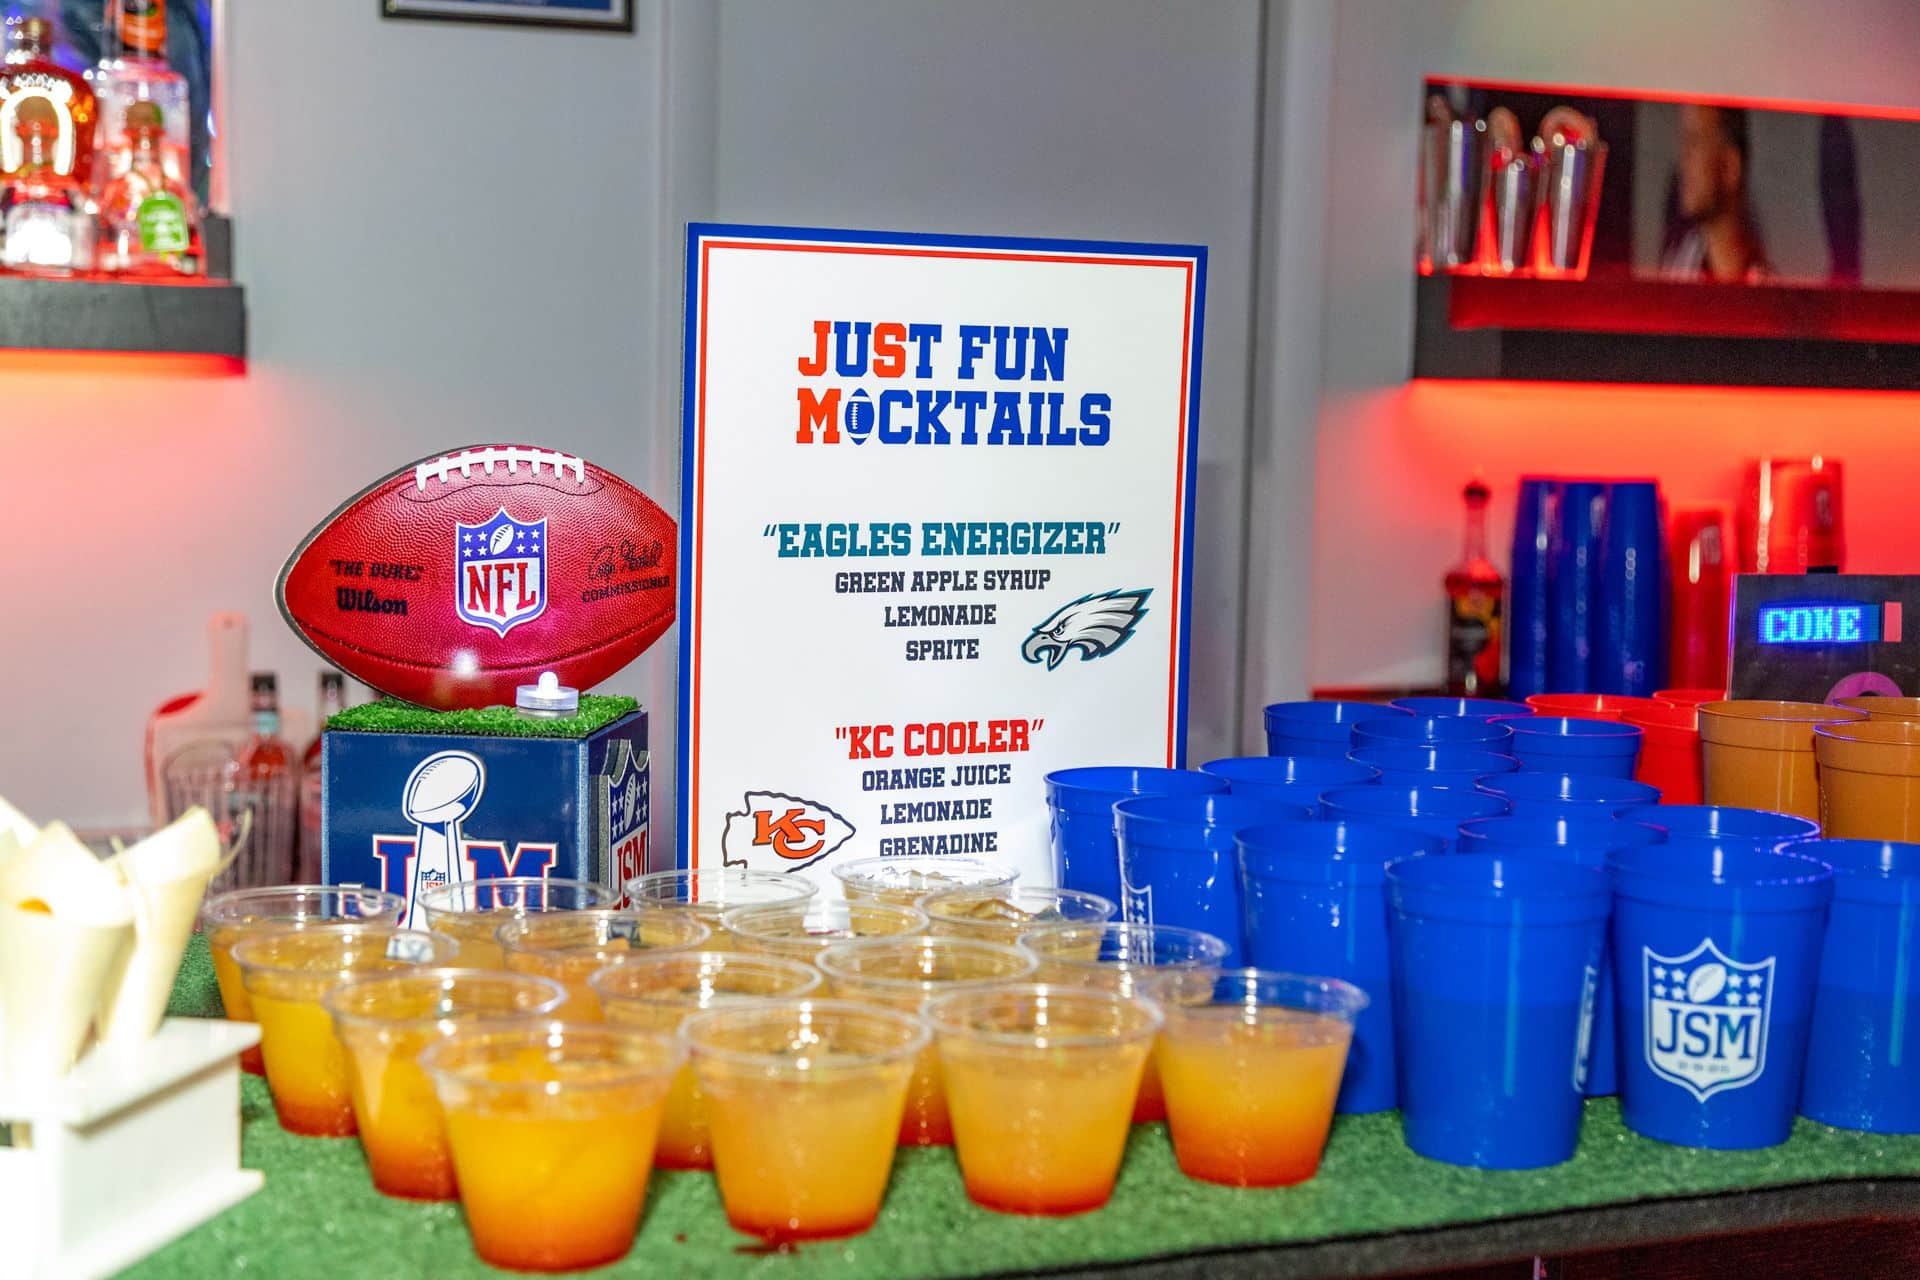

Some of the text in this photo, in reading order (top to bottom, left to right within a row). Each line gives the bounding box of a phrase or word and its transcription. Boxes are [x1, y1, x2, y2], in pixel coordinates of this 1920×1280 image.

[798, 321, 1068, 381] JUST FUN
[764, 522, 1120, 558] "EAGLES ENERGIZER"
[466, 562, 537, 618] NFL
[581, 576, 671, 603] COMMISSIONER
[836, 569, 1050, 593] GREEN APPLE SYRUP
[337, 587, 408, 616] Wilson
[885, 604, 997, 627] LEMONADE
[1764, 607, 1860, 643] COKE
[906, 639, 979, 661] SPRITE
[836, 719, 1044, 759] "KC COOLER"
[863, 764, 1011, 791] ORANGE JUICE
[881, 799, 992, 824] LEMONADE
[752, 808, 826, 859] KC
[880, 832, 998, 857] GRENADINE
[1656, 1007, 1756, 1060] JSM
